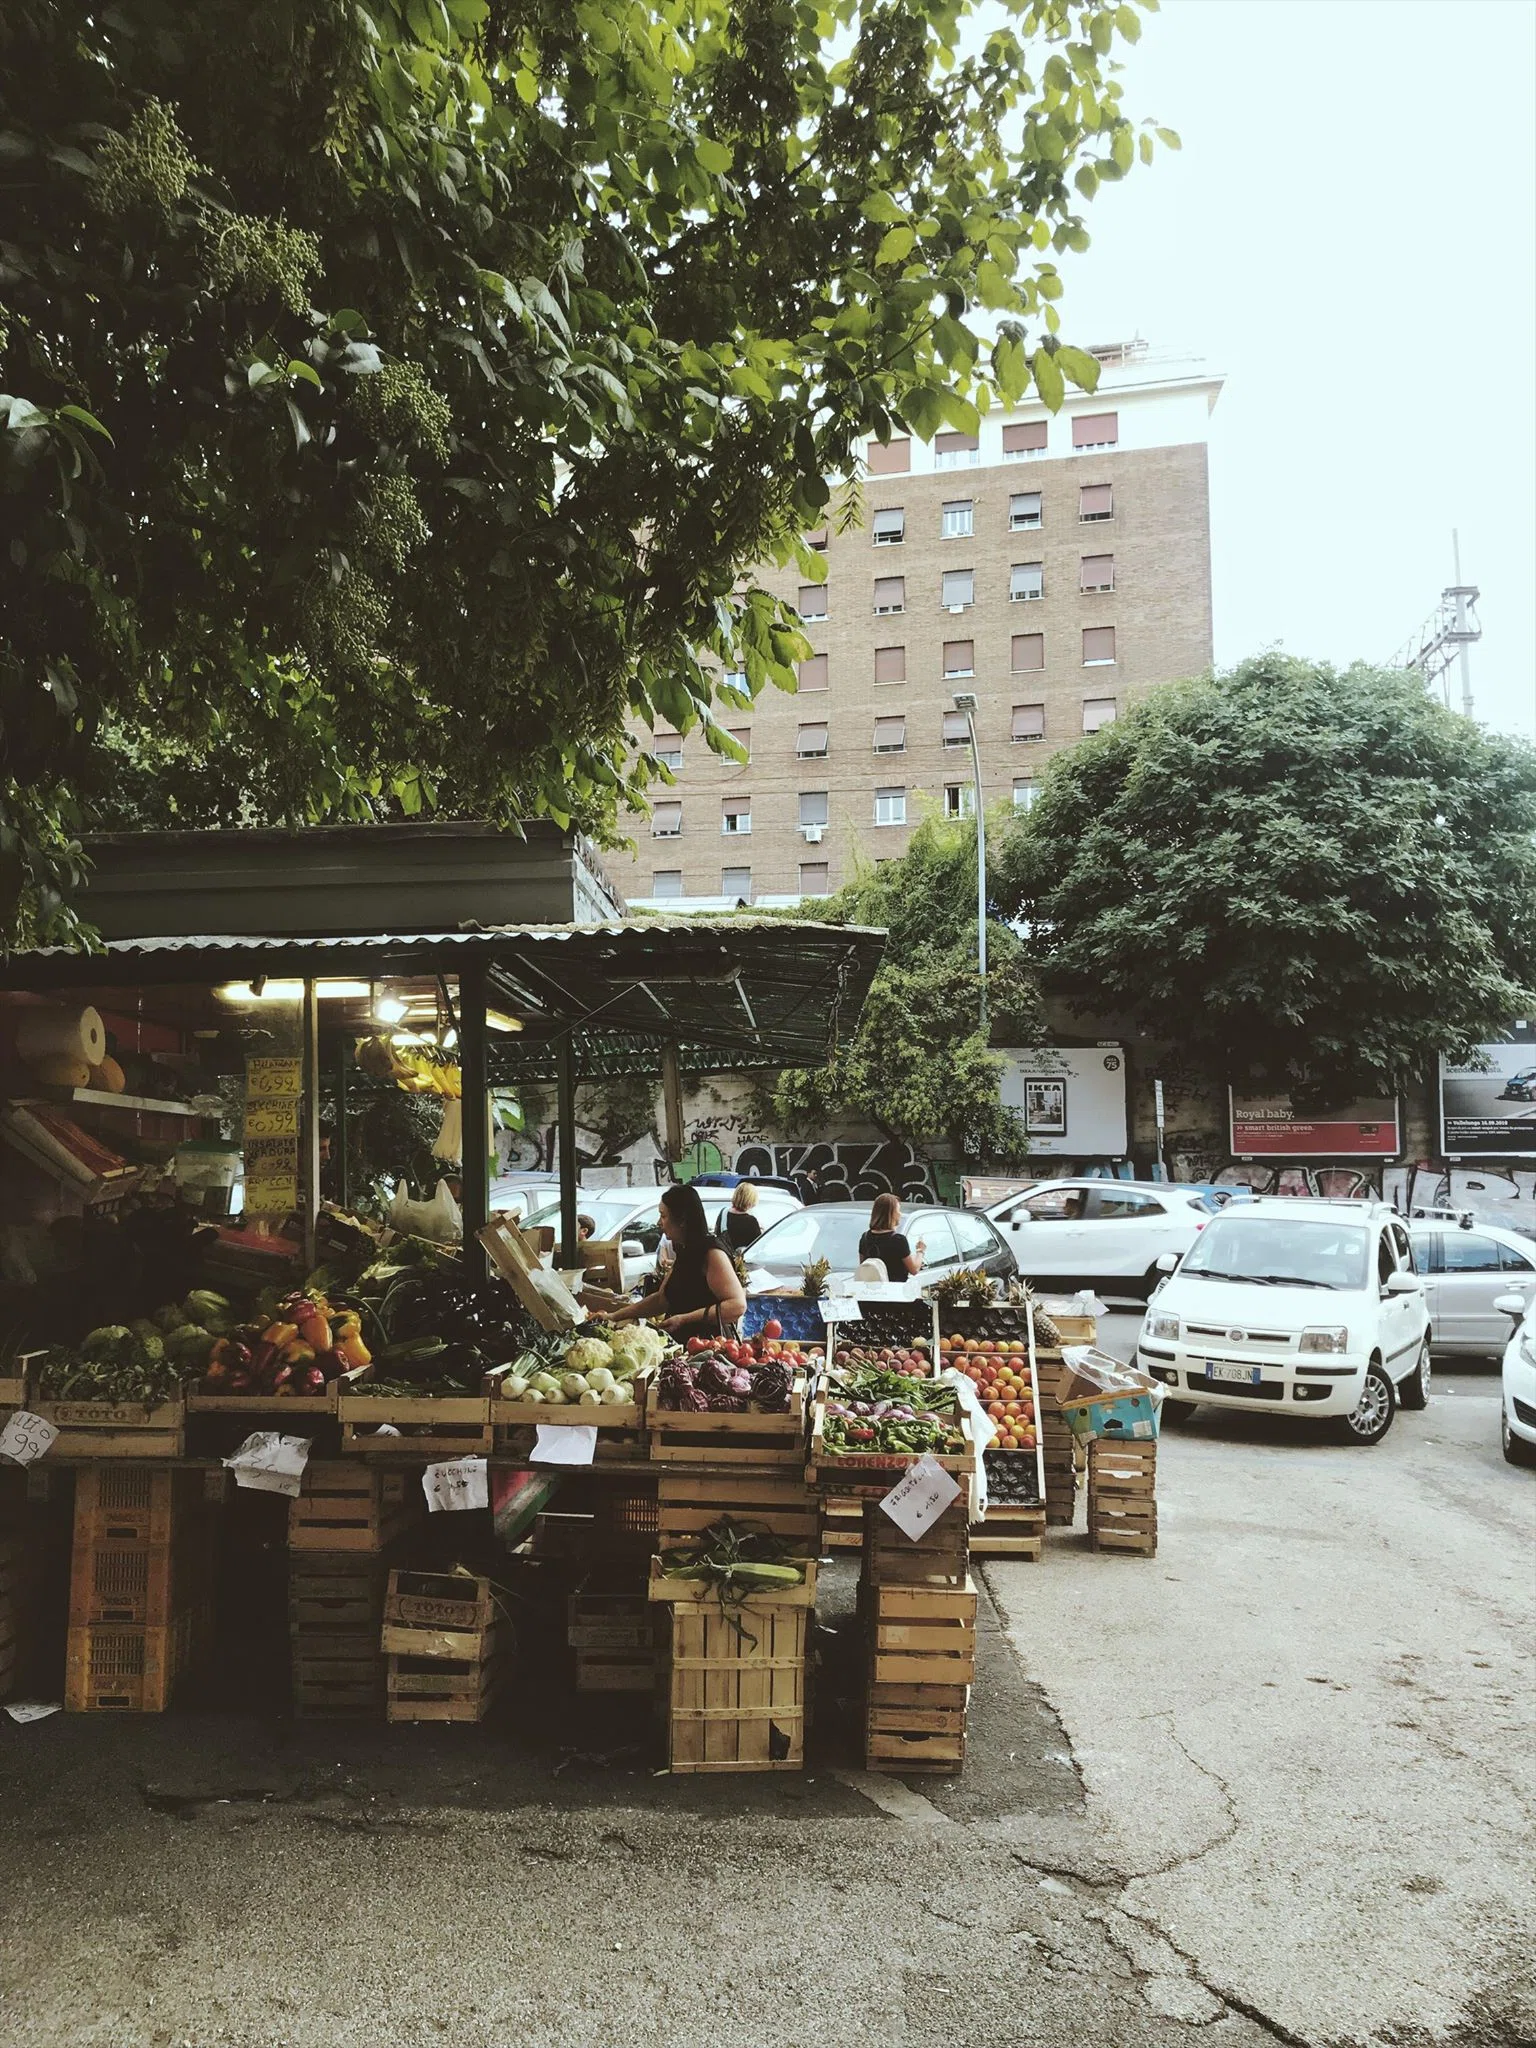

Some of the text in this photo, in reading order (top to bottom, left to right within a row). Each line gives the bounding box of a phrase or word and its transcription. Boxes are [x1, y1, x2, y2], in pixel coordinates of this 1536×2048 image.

[1106, 1061, 1118, 1069] 75
[1027, 1084, 1062, 1092] IKEA
[1235, 1109, 1295, 1120] Royal baby.
